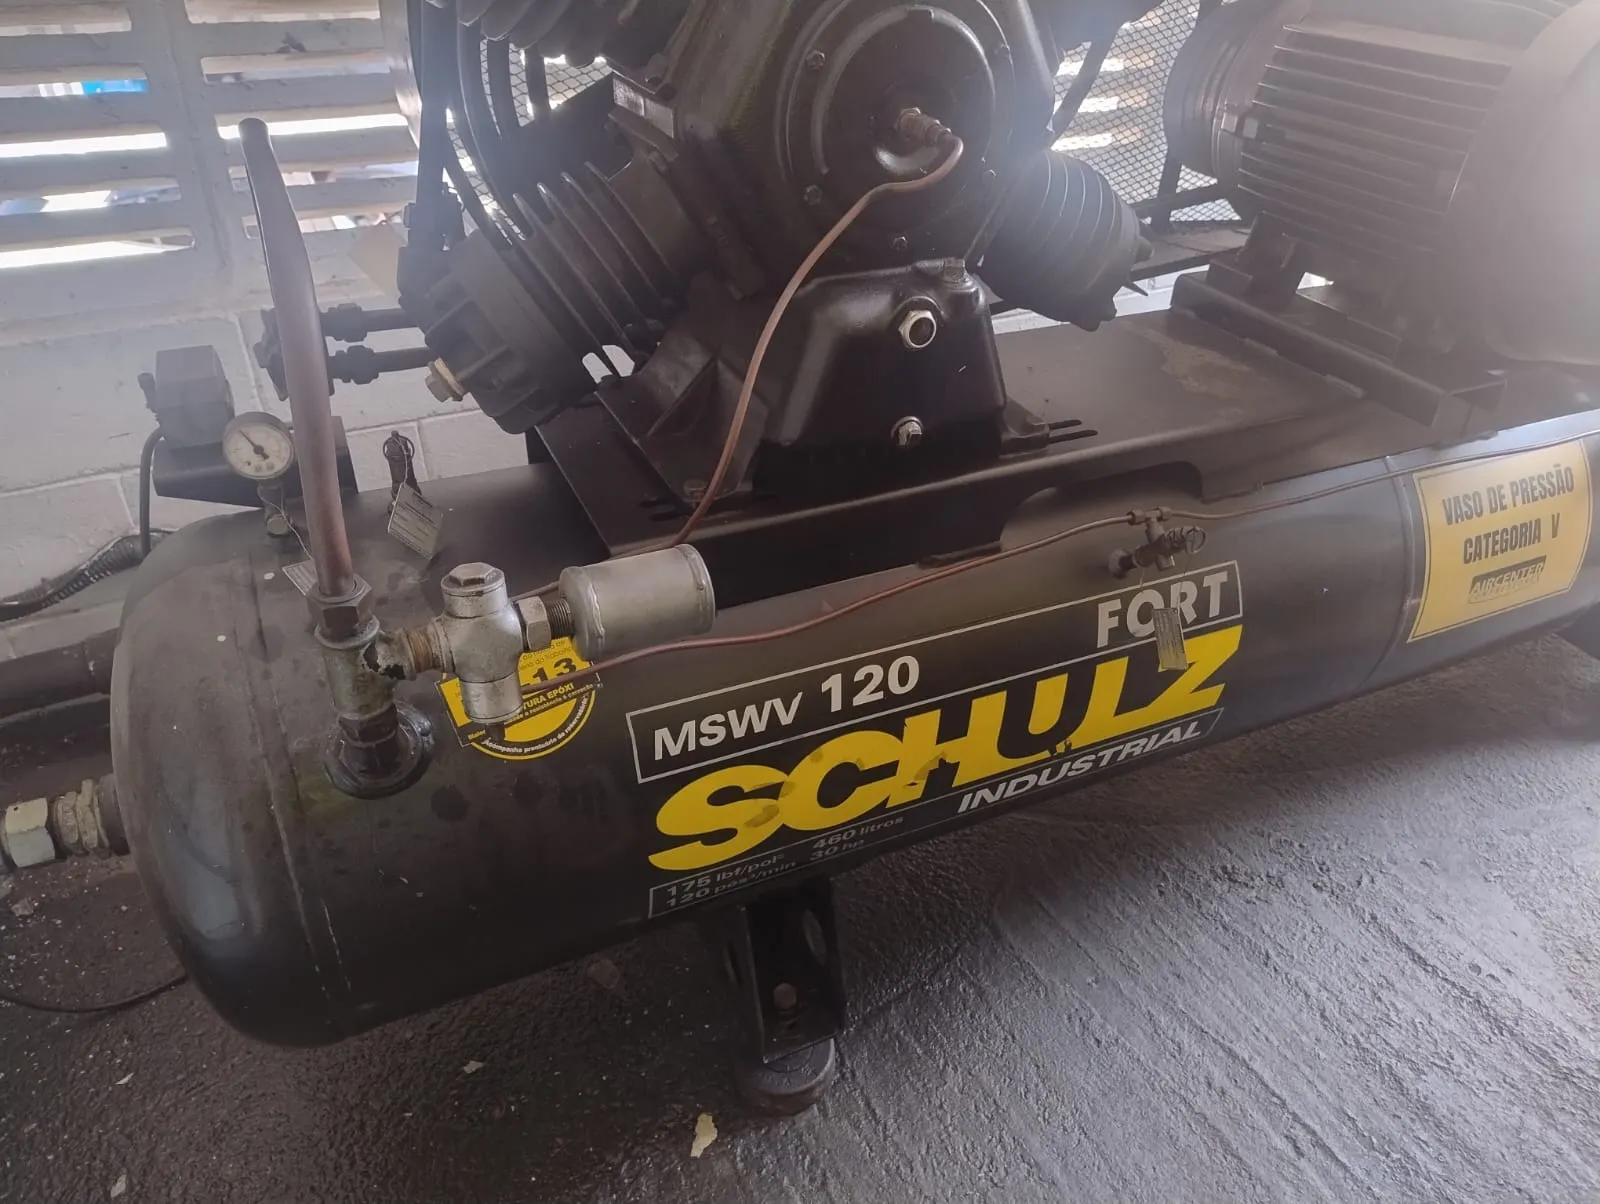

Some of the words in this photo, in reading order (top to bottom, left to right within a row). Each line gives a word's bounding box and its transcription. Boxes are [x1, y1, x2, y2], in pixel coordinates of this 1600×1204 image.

[1442, 490, 1483, 526] VASO
[1486, 484, 1507, 514] DE
[1509, 463, 1575, 508] PRESSÃO
[1463, 518, 1541, 565] CATEGORIA
[1551, 512, 1560, 539] V
[1097, 571, 1228, 649] FORT
[1471, 562, 1544, 596] AIRCENTER
[523, 695, 547, 710] TURA
[547, 682, 575, 700] EPÓXI
[654, 692, 803, 761] MSWV
[821, 655, 920, 713] 120
[648, 624, 1243, 871] SCHULZ
[958, 721, 1201, 813] INDUSTRIAL
[666, 887, 711, 908] 120
[809, 846, 839, 861] 30
[667, 876, 712, 898] 175
[812, 829, 857, 849] 460
[859, 817, 904, 836] litros
